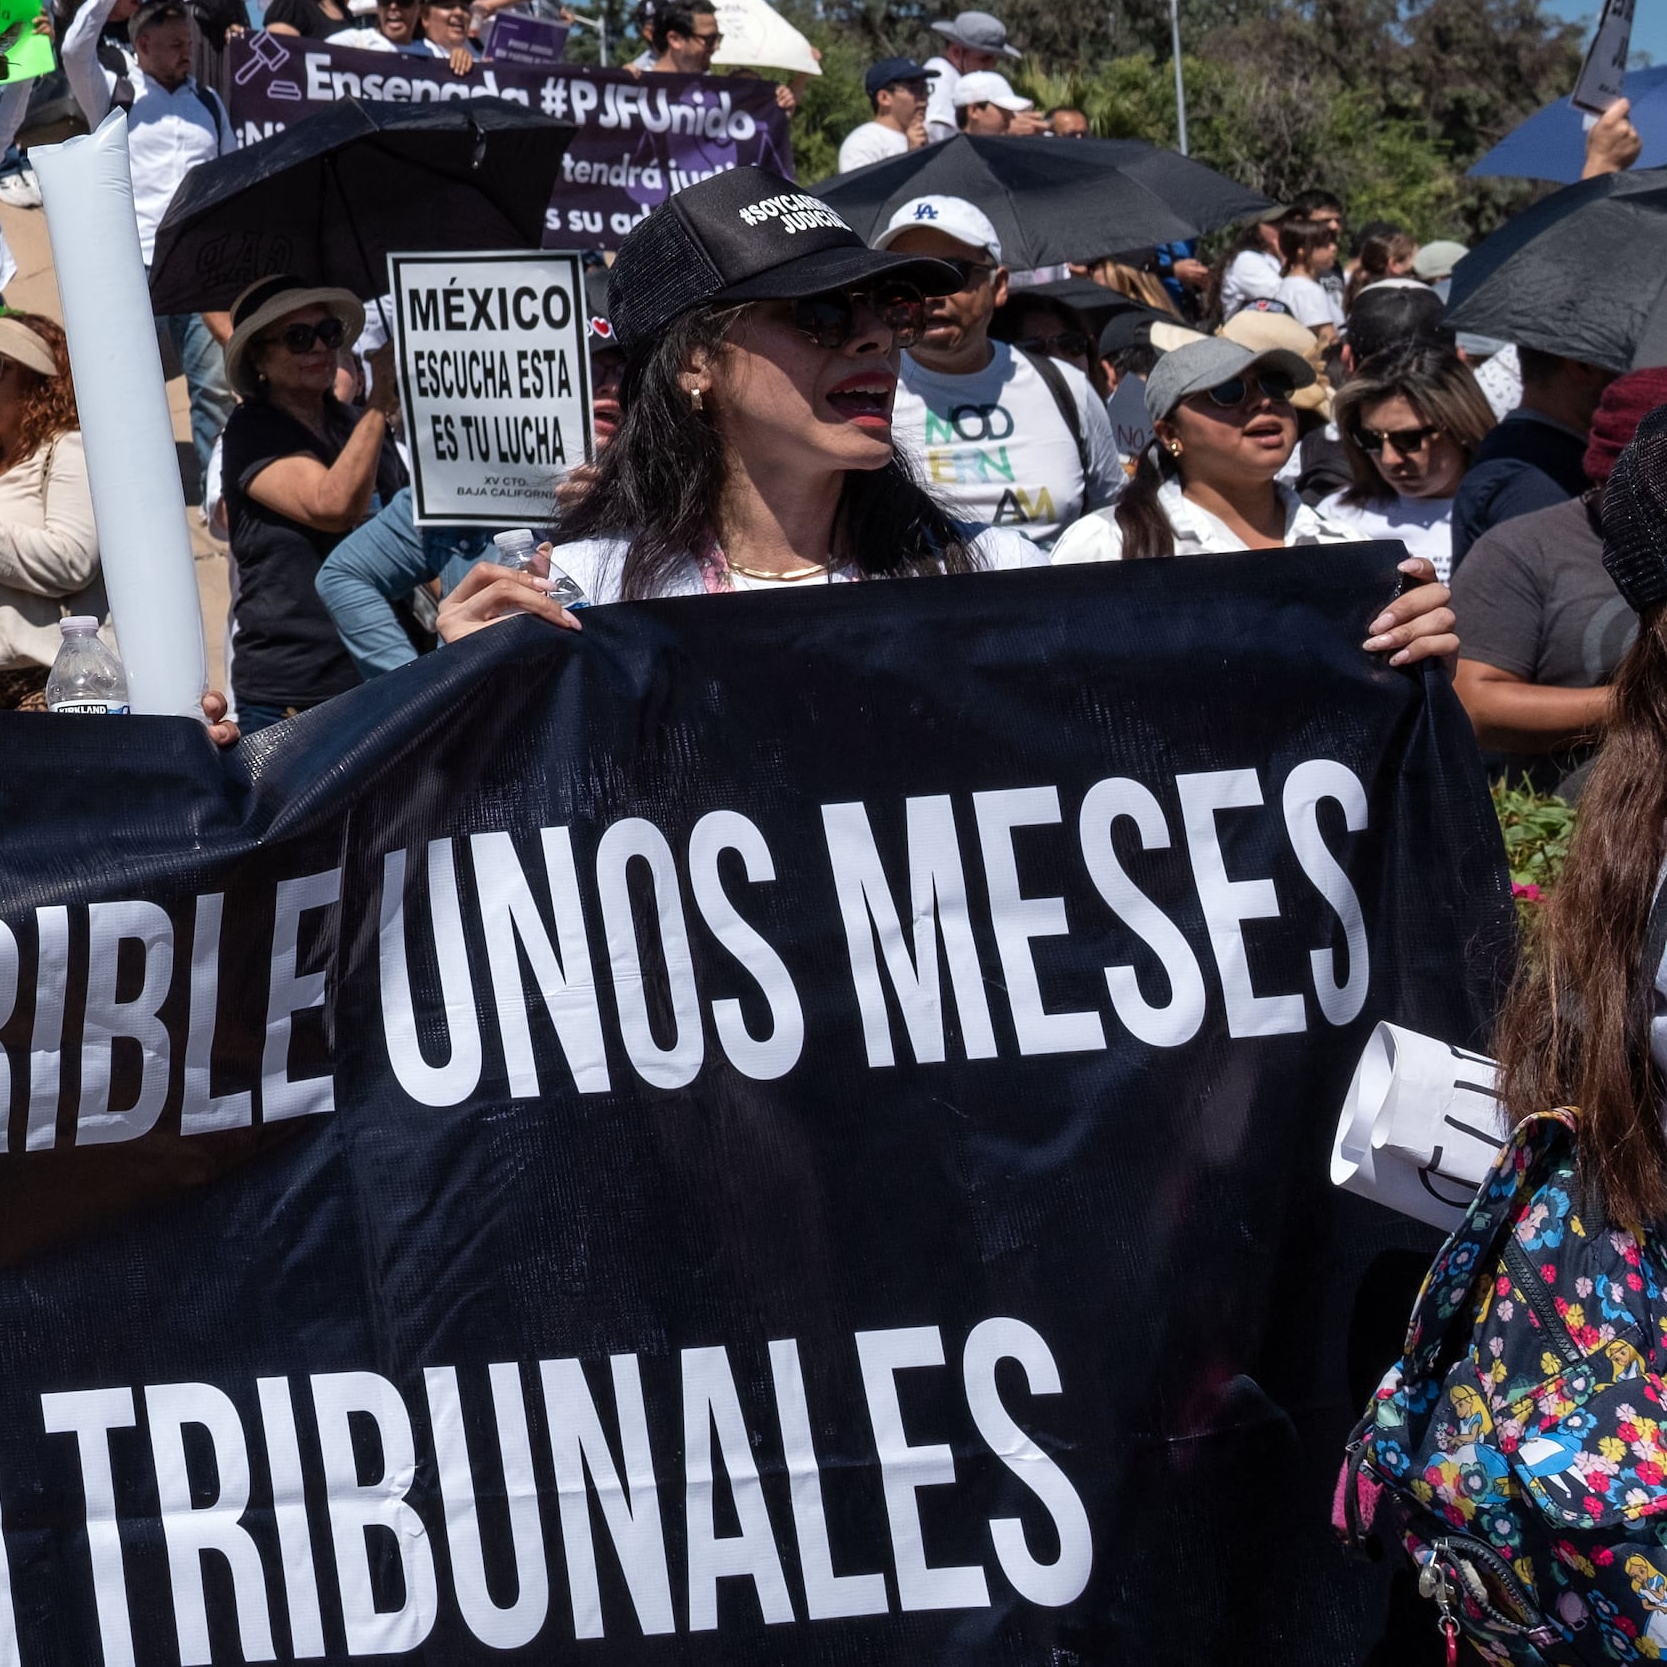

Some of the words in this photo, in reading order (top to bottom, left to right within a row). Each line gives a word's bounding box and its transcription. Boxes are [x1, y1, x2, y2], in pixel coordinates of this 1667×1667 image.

[540, 76, 757, 141] #PJFUnido
[562, 152, 664, 191] tendrá
[568, 208, 604, 233] su
[913, 202, 939, 221] LA
[408, 277, 571, 331] MÉXICO
[414, 350, 512, 399] ESCUCHA
[516, 349, 572, 399] ESTA
[431, 414, 458, 461] ES
[460, 415, 490, 463] TU
[494, 415, 566, 465] LUCHA
[457, 487, 487, 497] BAJA
[484, 476, 499, 486] XV
[378, 808, 805, 1109] UNOS
[819, 758, 1370, 1069] MESES
[41, 1316, 1095, 1667] TRIBUNALES
